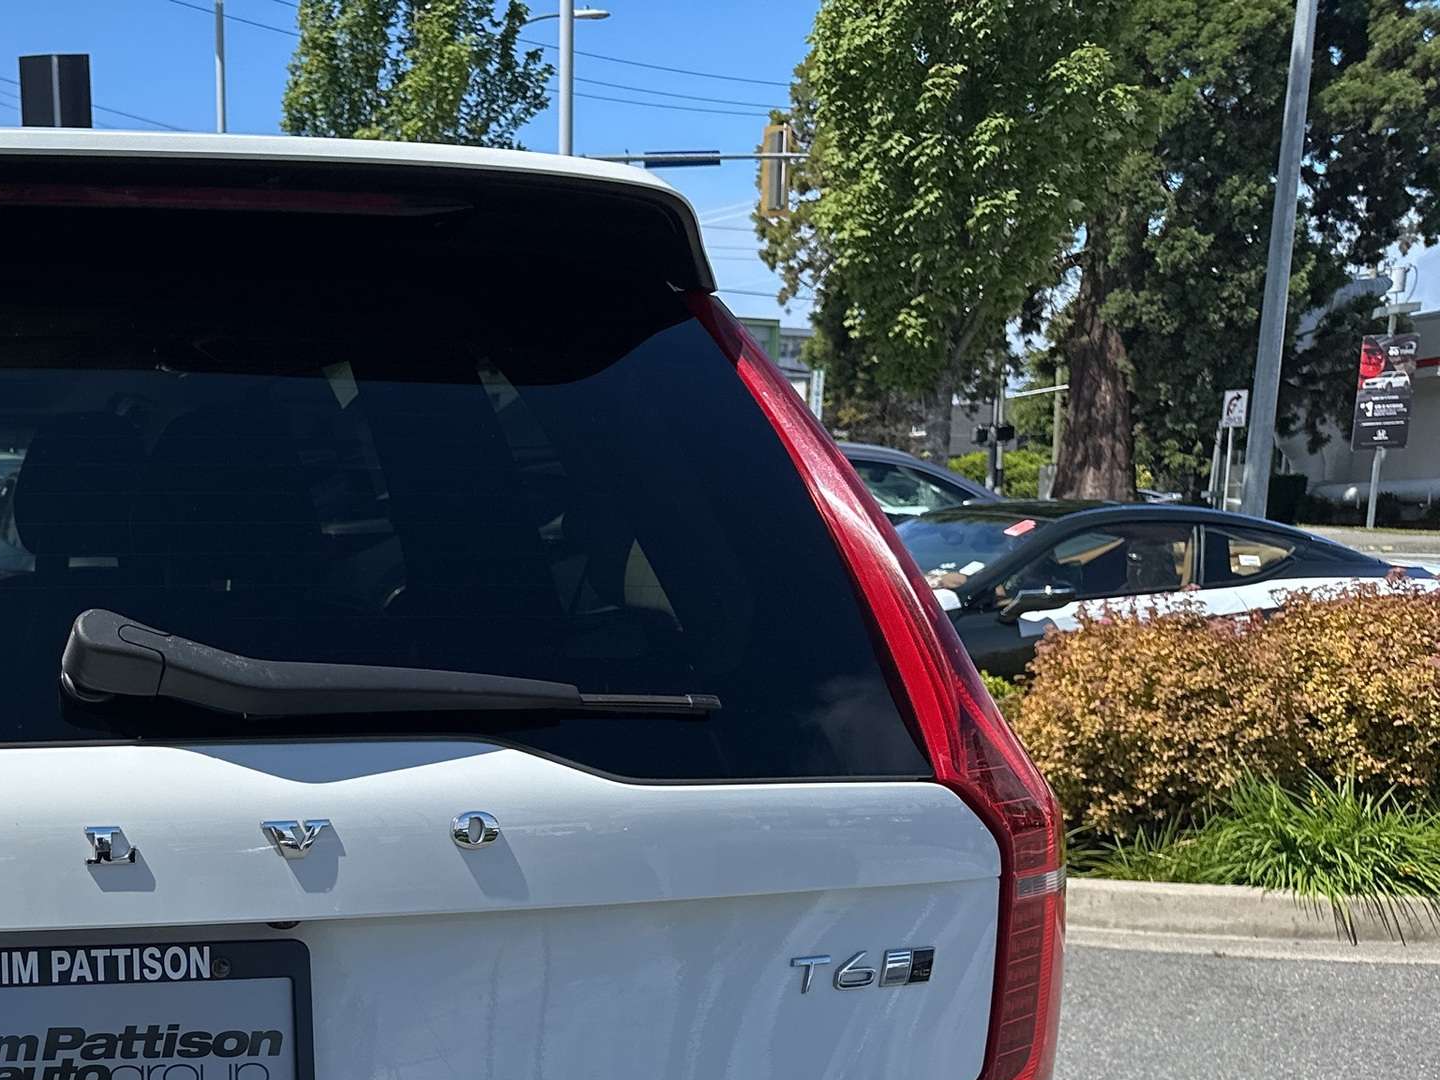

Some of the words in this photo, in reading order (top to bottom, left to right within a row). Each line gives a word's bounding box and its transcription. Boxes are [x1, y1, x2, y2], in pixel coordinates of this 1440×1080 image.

[51, 946, 211, 983] PATTISON
[790, 950, 876, 993] T6
[42, 1024, 283, 1062] Pattison
